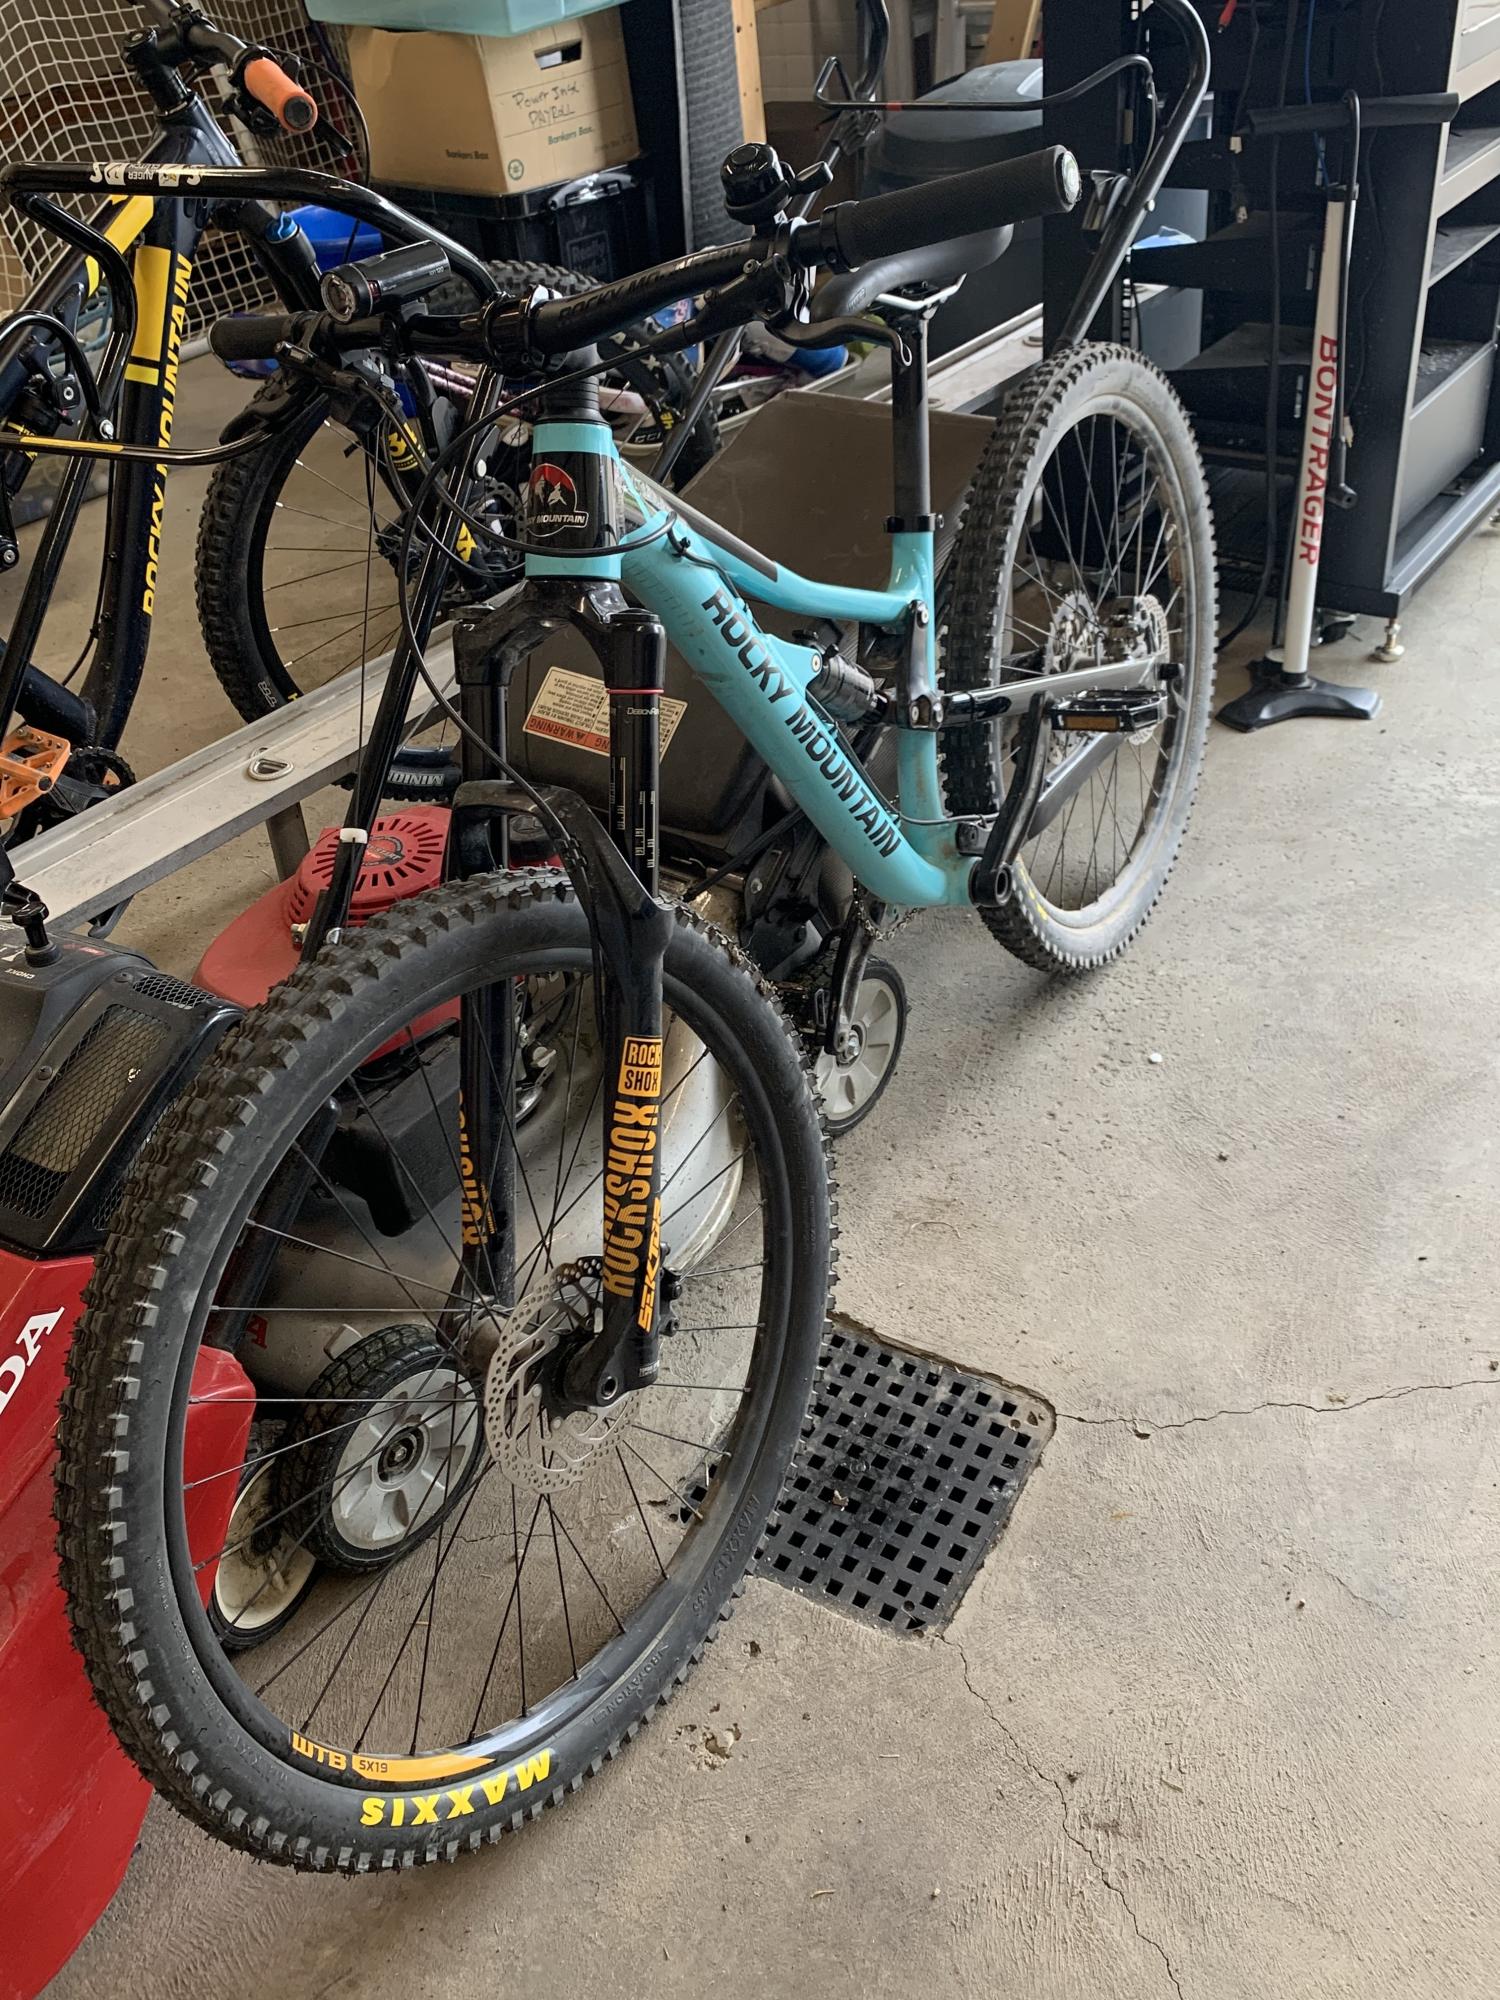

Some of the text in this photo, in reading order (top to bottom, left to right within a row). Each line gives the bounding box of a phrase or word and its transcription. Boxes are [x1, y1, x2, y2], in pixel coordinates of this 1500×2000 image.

[548, 126, 594, 146] Bankers Box
[128, 171, 155, 181] AUGER
[1299, 335, 1338, 566] BONTRAGER
[536, 514, 586, 524] MOUNTAIN
[529, 717, 575, 740] WARNING
[701, 587, 901, 858] ROCKY MOUNTAIN
[627, 1042, 661, 1067] ROCK
[624, 1069, 659, 1092] SHOX
[603, 1100, 659, 1299] ROCKSHOX
[292, 1731, 388, 1775] WTB SX19
[359, 1747, 552, 1828] MAXXIS
